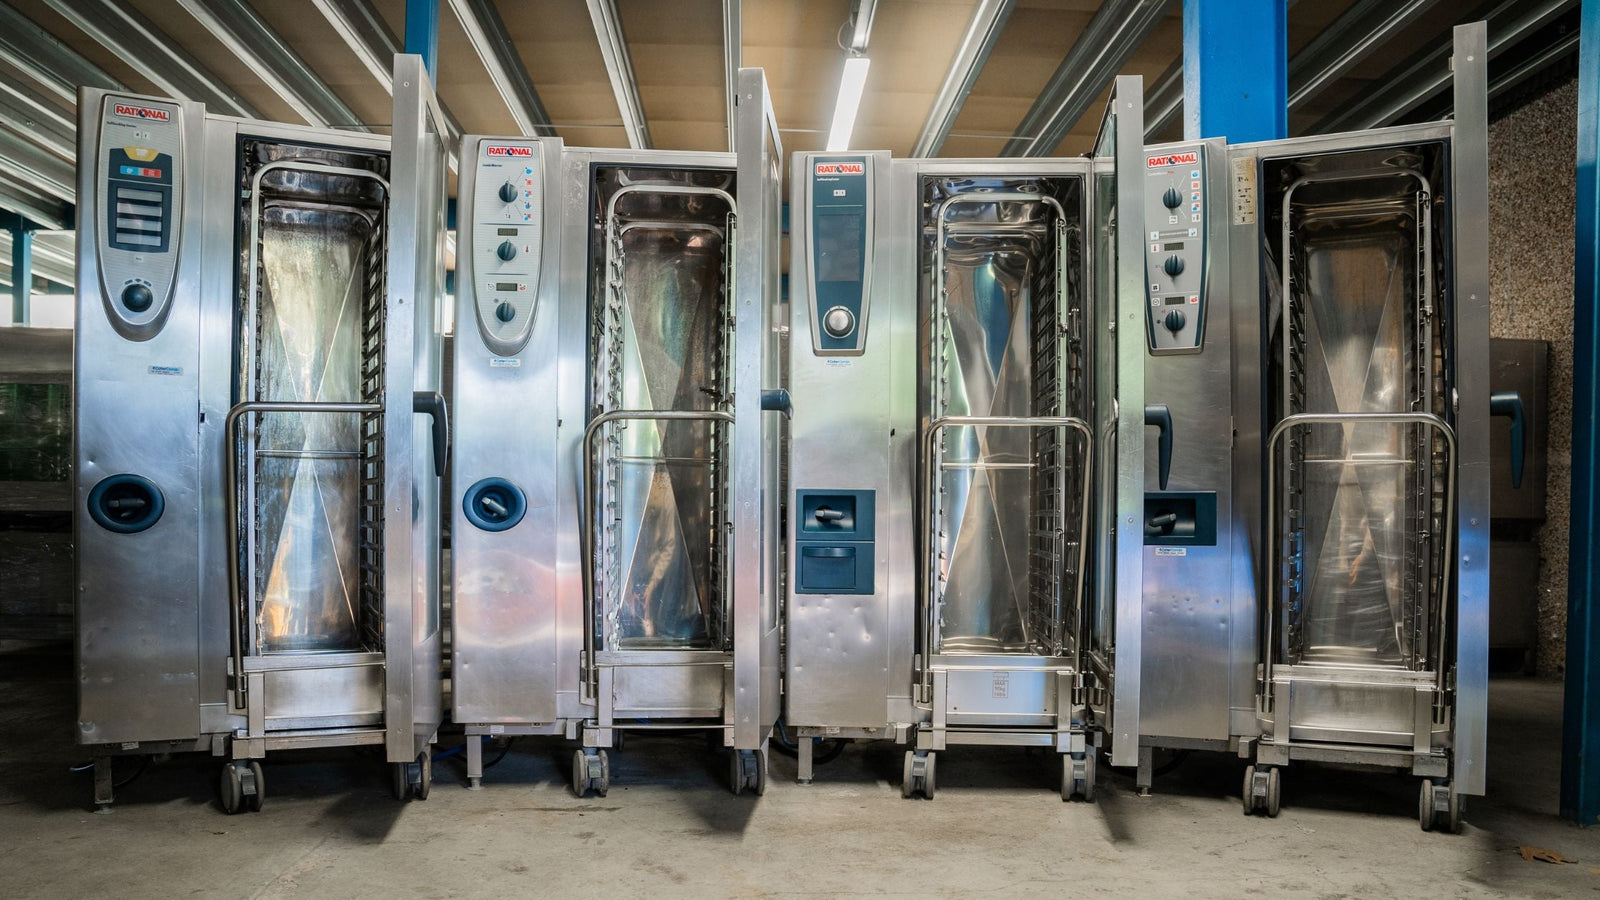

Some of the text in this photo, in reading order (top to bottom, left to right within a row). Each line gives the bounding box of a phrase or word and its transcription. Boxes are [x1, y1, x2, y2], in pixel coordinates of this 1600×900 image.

[116, 105, 168, 120] RATIONAL
[488, 147, 532, 156] RATIONAL
[1148, 153, 1196, 166] RATIONAL
[817, 164, 863, 173] RATIONAL
